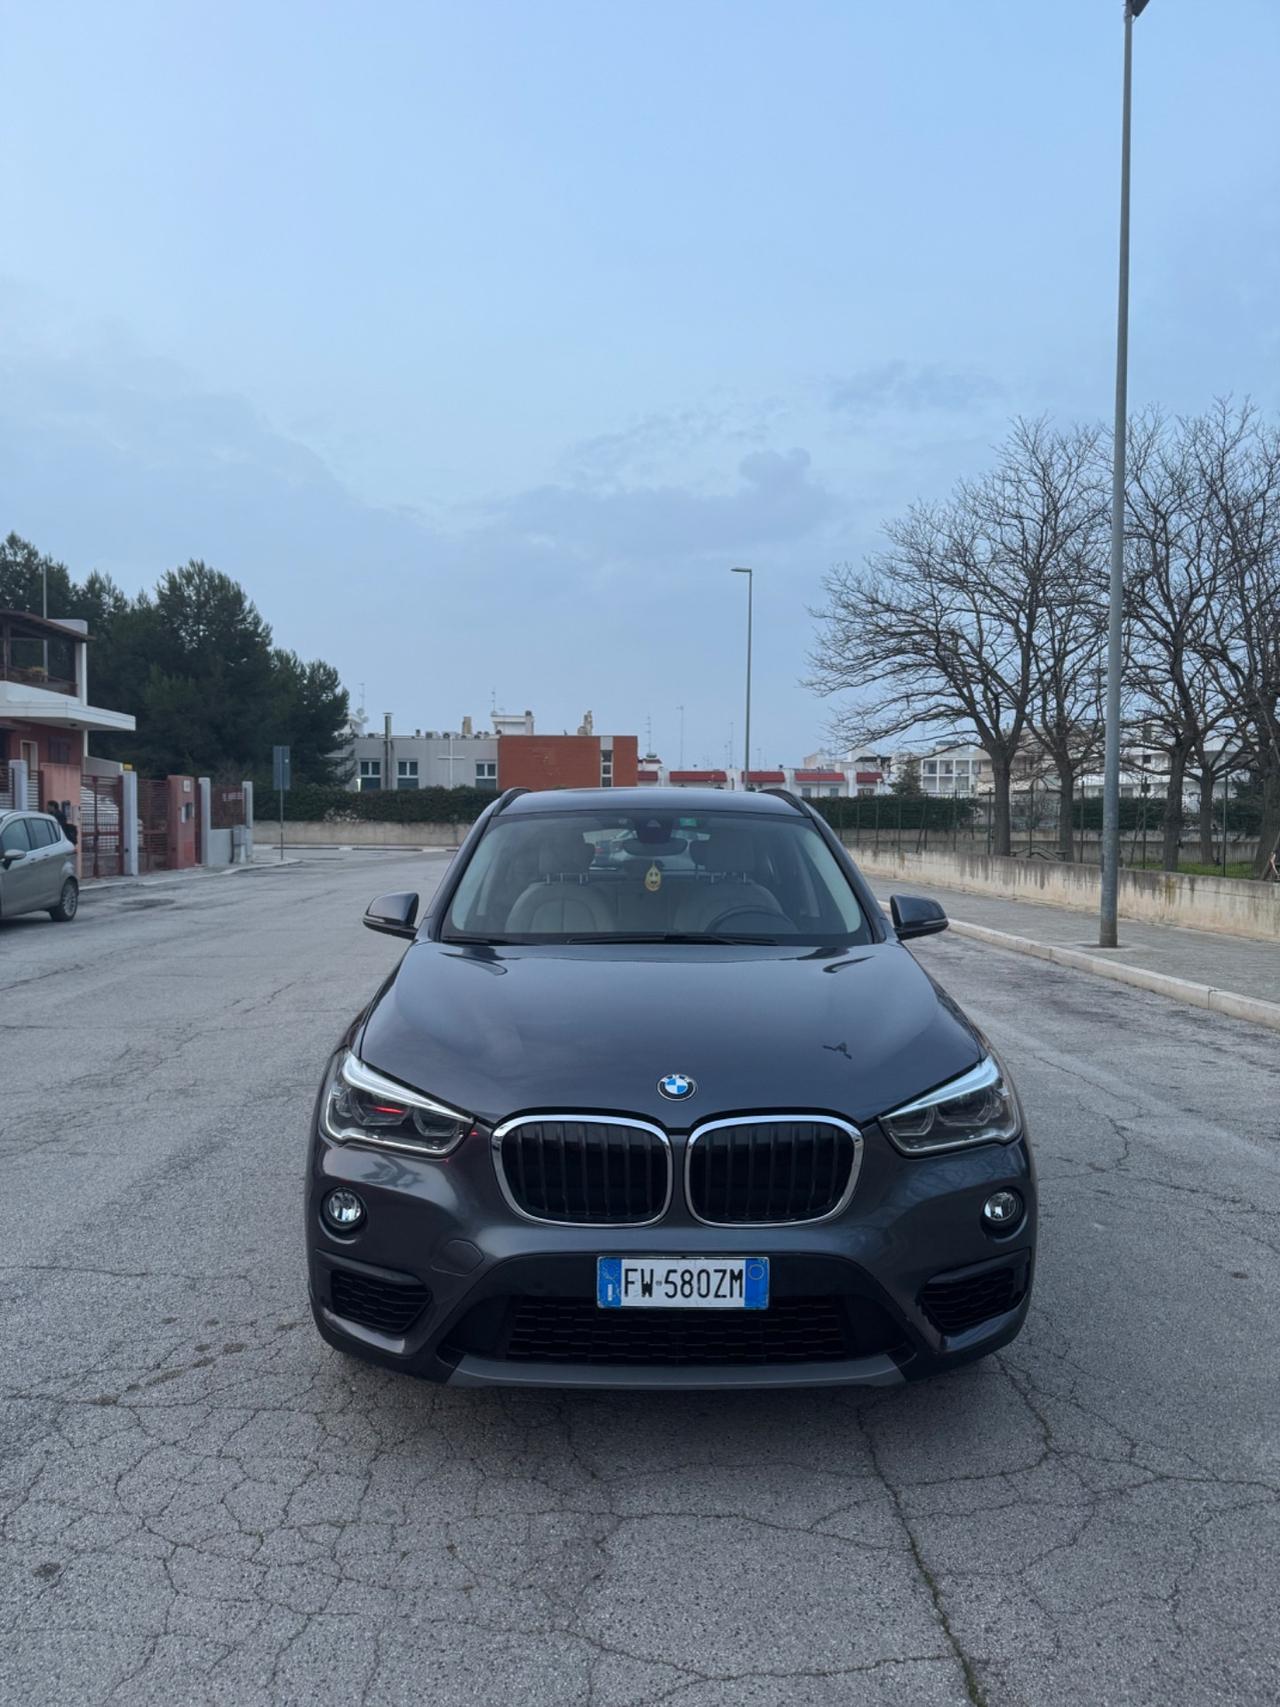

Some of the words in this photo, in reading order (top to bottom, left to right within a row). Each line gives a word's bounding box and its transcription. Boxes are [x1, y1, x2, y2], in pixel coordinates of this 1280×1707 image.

[608, 1284, 613, 1301] I
[624, 1268, 654, 1298] FW
[664, 1268, 743, 1299] 580ZM
